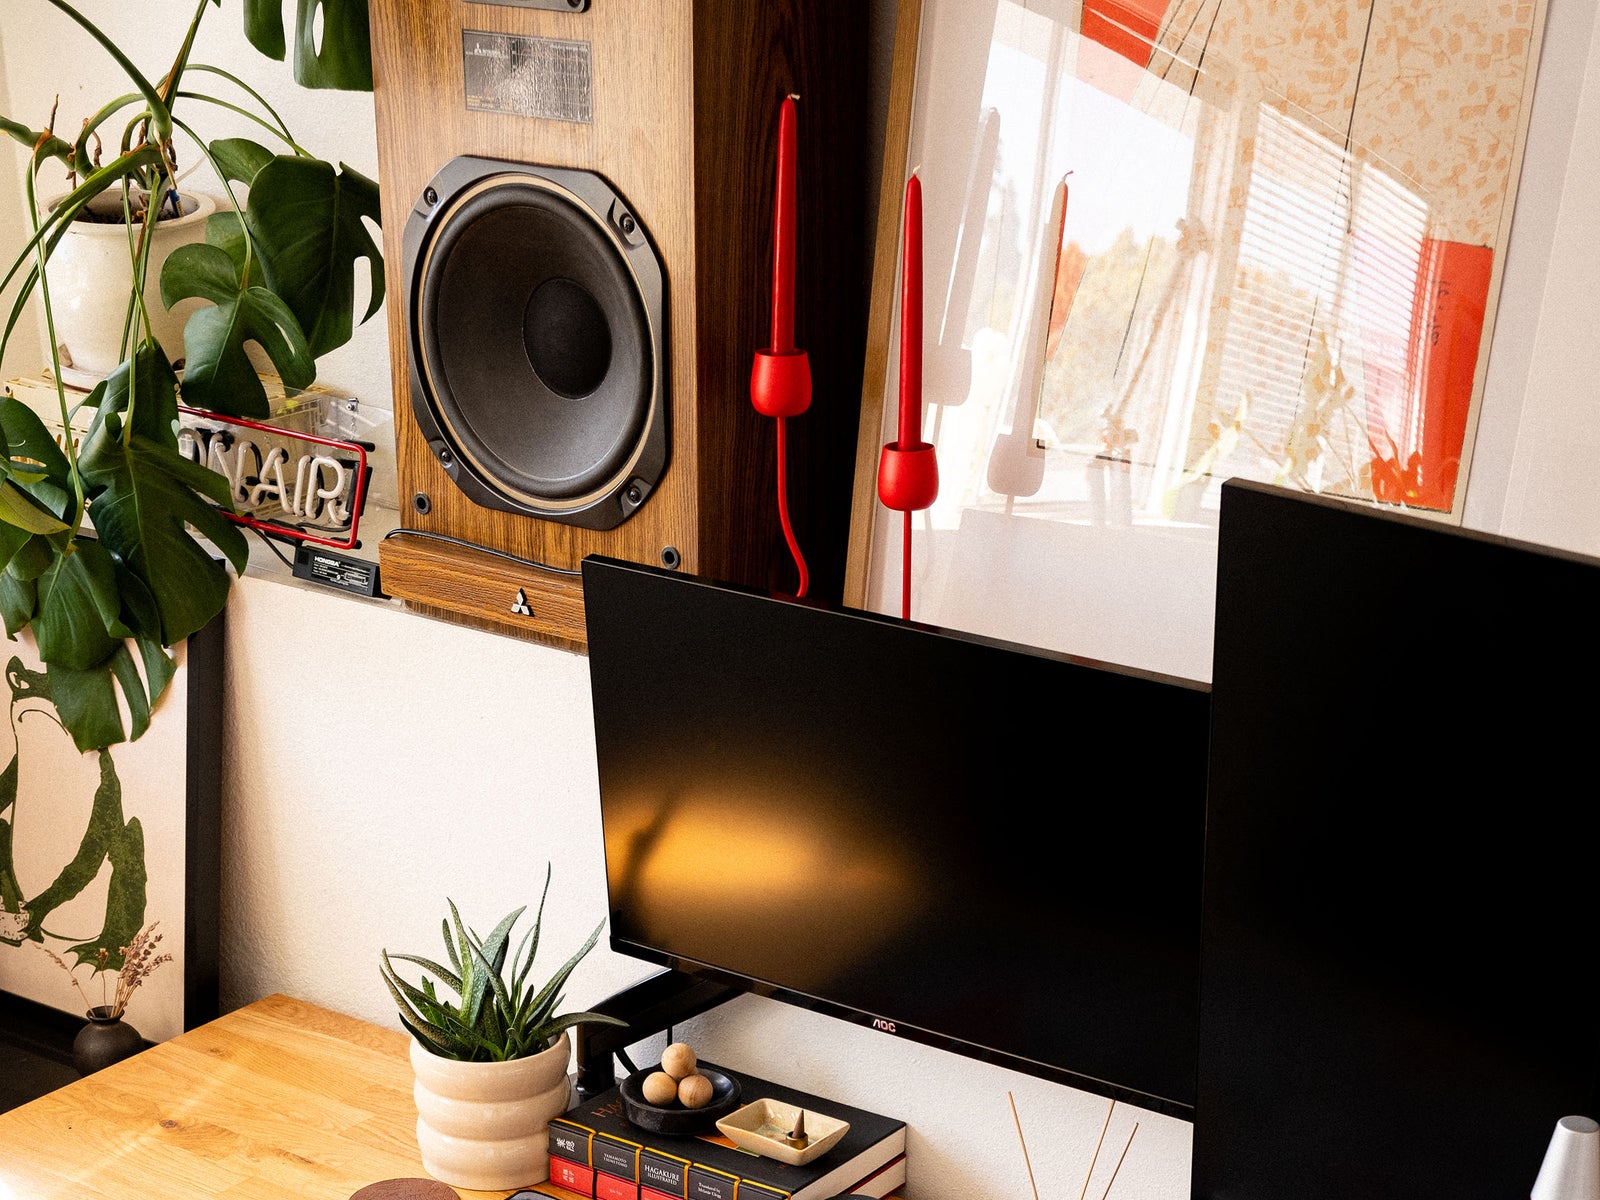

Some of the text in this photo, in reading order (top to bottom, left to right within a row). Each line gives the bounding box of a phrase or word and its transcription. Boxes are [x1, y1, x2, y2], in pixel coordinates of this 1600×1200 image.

[251, 447, 350, 526] AIR
[872, 1018, 896, 1033] AOC
[644, 1164, 680, 1182] HAGAKURE
[647, 1172, 678, 1186] ILLUSTRATED
